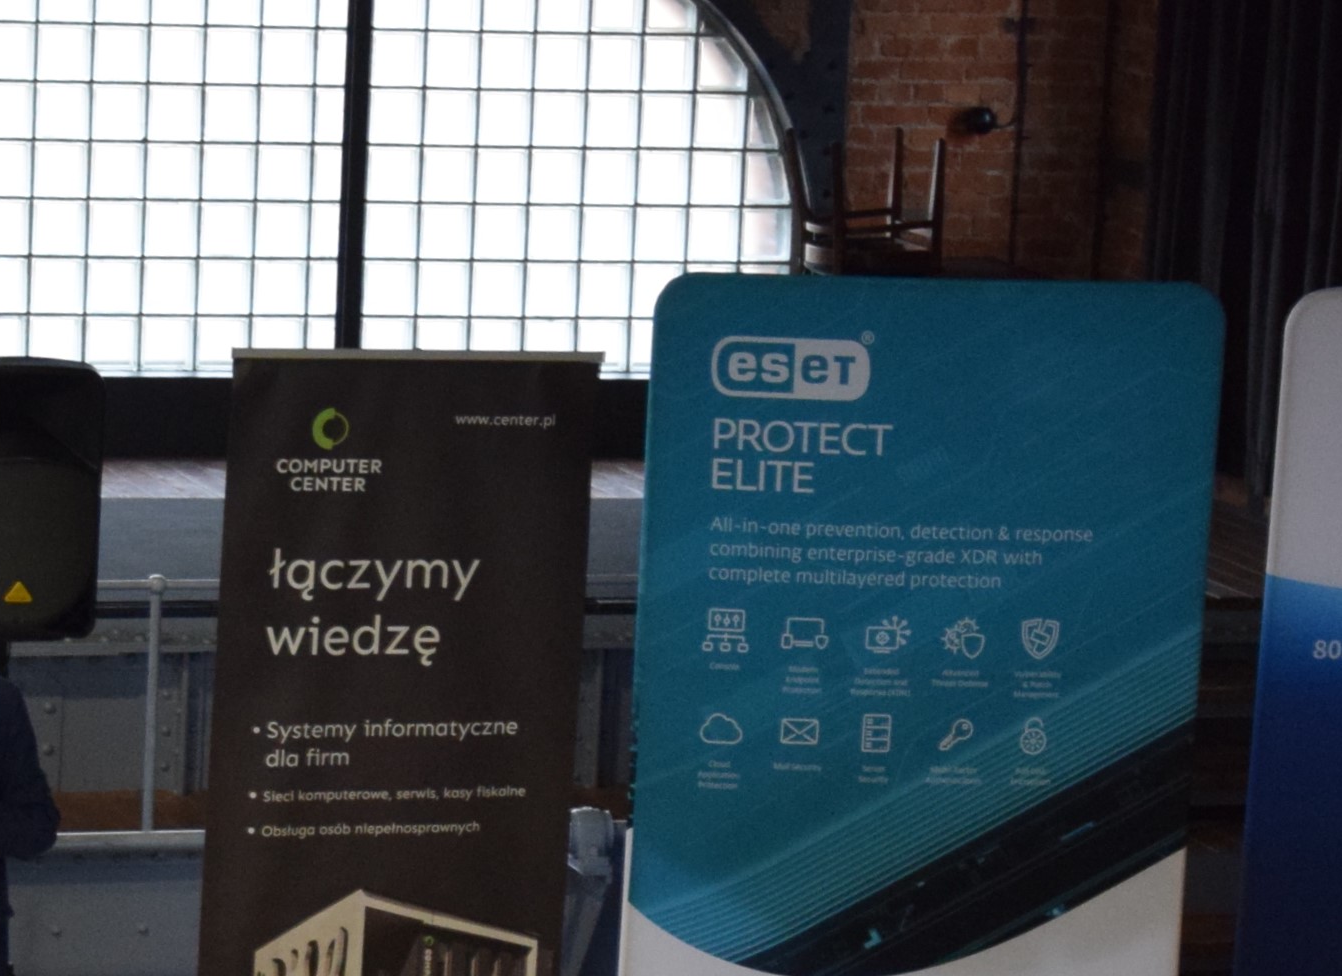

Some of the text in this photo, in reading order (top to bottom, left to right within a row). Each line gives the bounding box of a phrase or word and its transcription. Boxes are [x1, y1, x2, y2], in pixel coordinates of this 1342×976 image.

[455, 413, 556, 429] www.center.pl
[712, 417, 893, 456] PROTECT
[276, 458, 383, 475] COMPUTER
[711, 458, 815, 493] ELITE
[290, 476, 366, 492] CENTER
[710, 515, 1094, 545] All-in-one prevention, detection & response
[709, 541, 1043, 567] combining enterprise-grade XDR with
[269, 548, 481, 602] łączymy
[708, 565, 1002, 590] complete multilayered protection
[266, 614, 441, 667] wiedzę
[266, 718, 519, 743] Systemy informatyczne
[265, 748, 350, 767] dla firm
[262, 784, 527, 803] Sieci komputerowe, serwis, kasy fiskalne
[261, 821, 480, 840] Obsługa osób niepełnosprawnych
